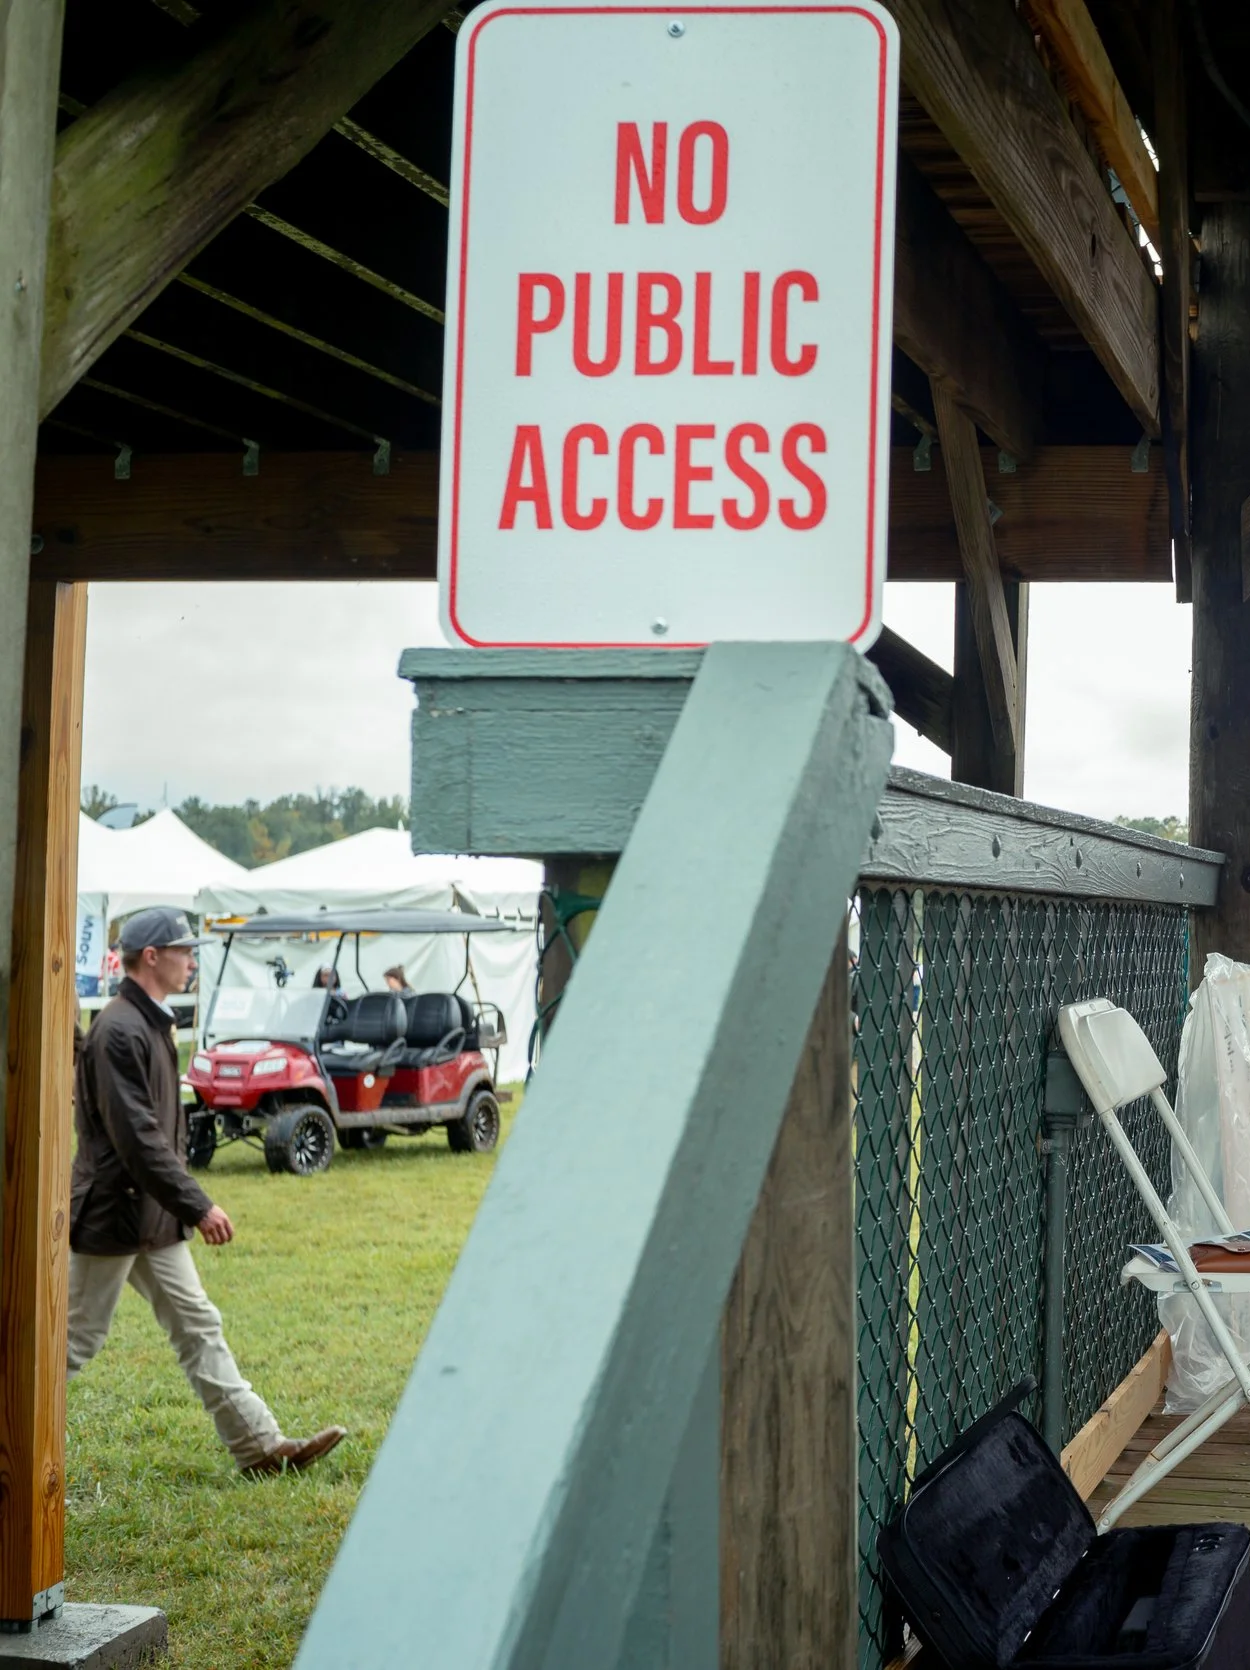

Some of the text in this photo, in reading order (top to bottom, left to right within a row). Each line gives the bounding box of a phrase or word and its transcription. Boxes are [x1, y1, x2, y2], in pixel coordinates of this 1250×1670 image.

[614, 121, 729, 226] NO
[515, 270, 819, 378] PUBLIC
[498, 422, 828, 531] ACCESS
